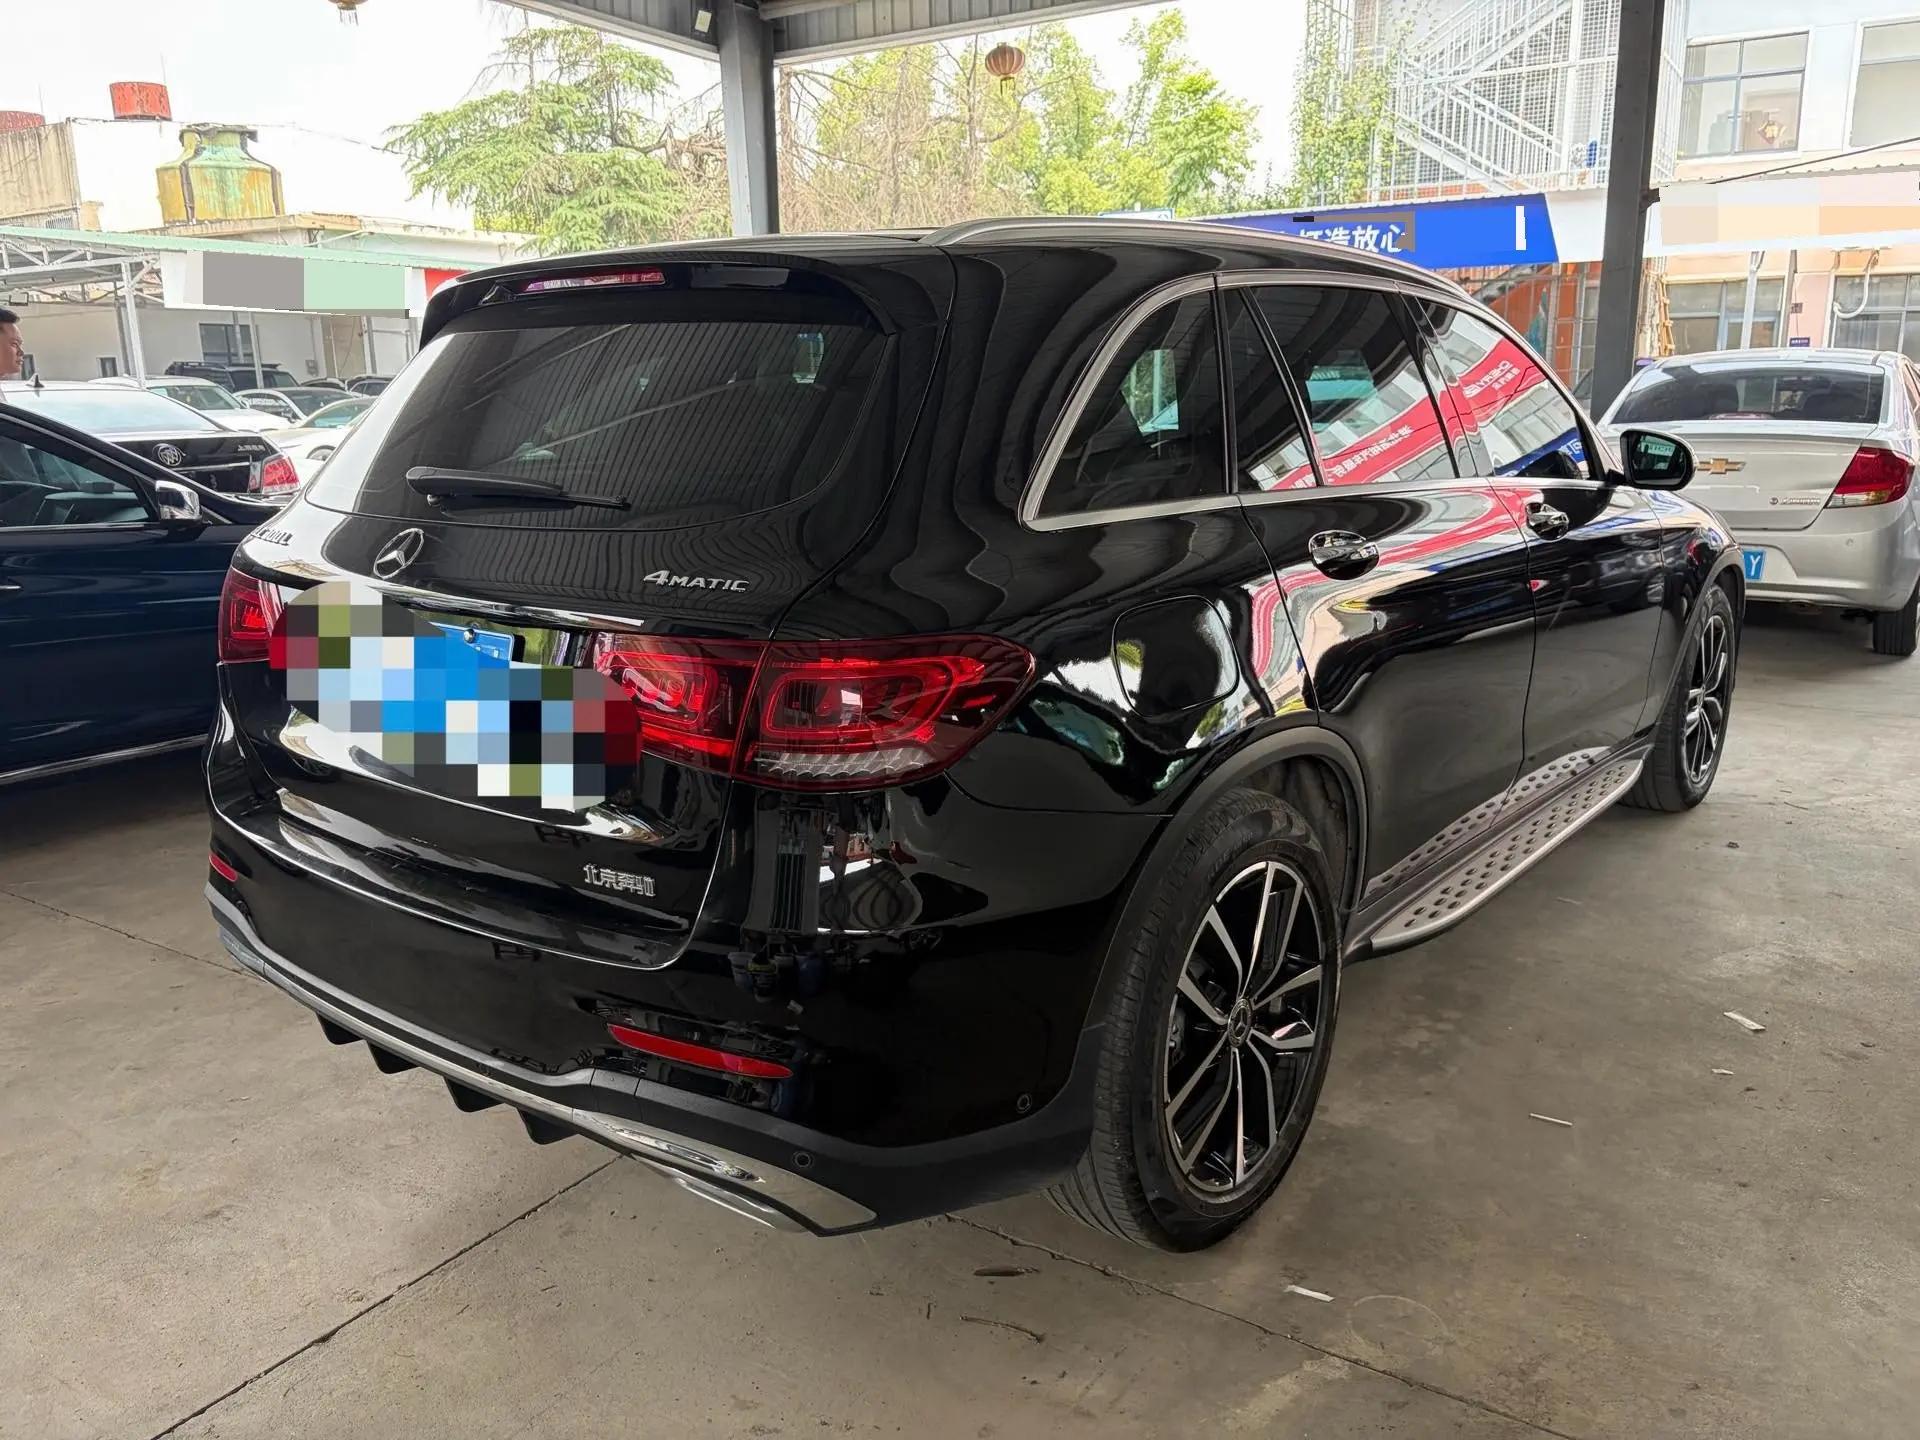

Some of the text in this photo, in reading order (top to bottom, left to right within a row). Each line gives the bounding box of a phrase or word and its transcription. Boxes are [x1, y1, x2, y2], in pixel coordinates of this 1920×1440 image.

[643, 569, 750, 593] 4MATIC
[583, 864, 656, 897] 北京奔驰
